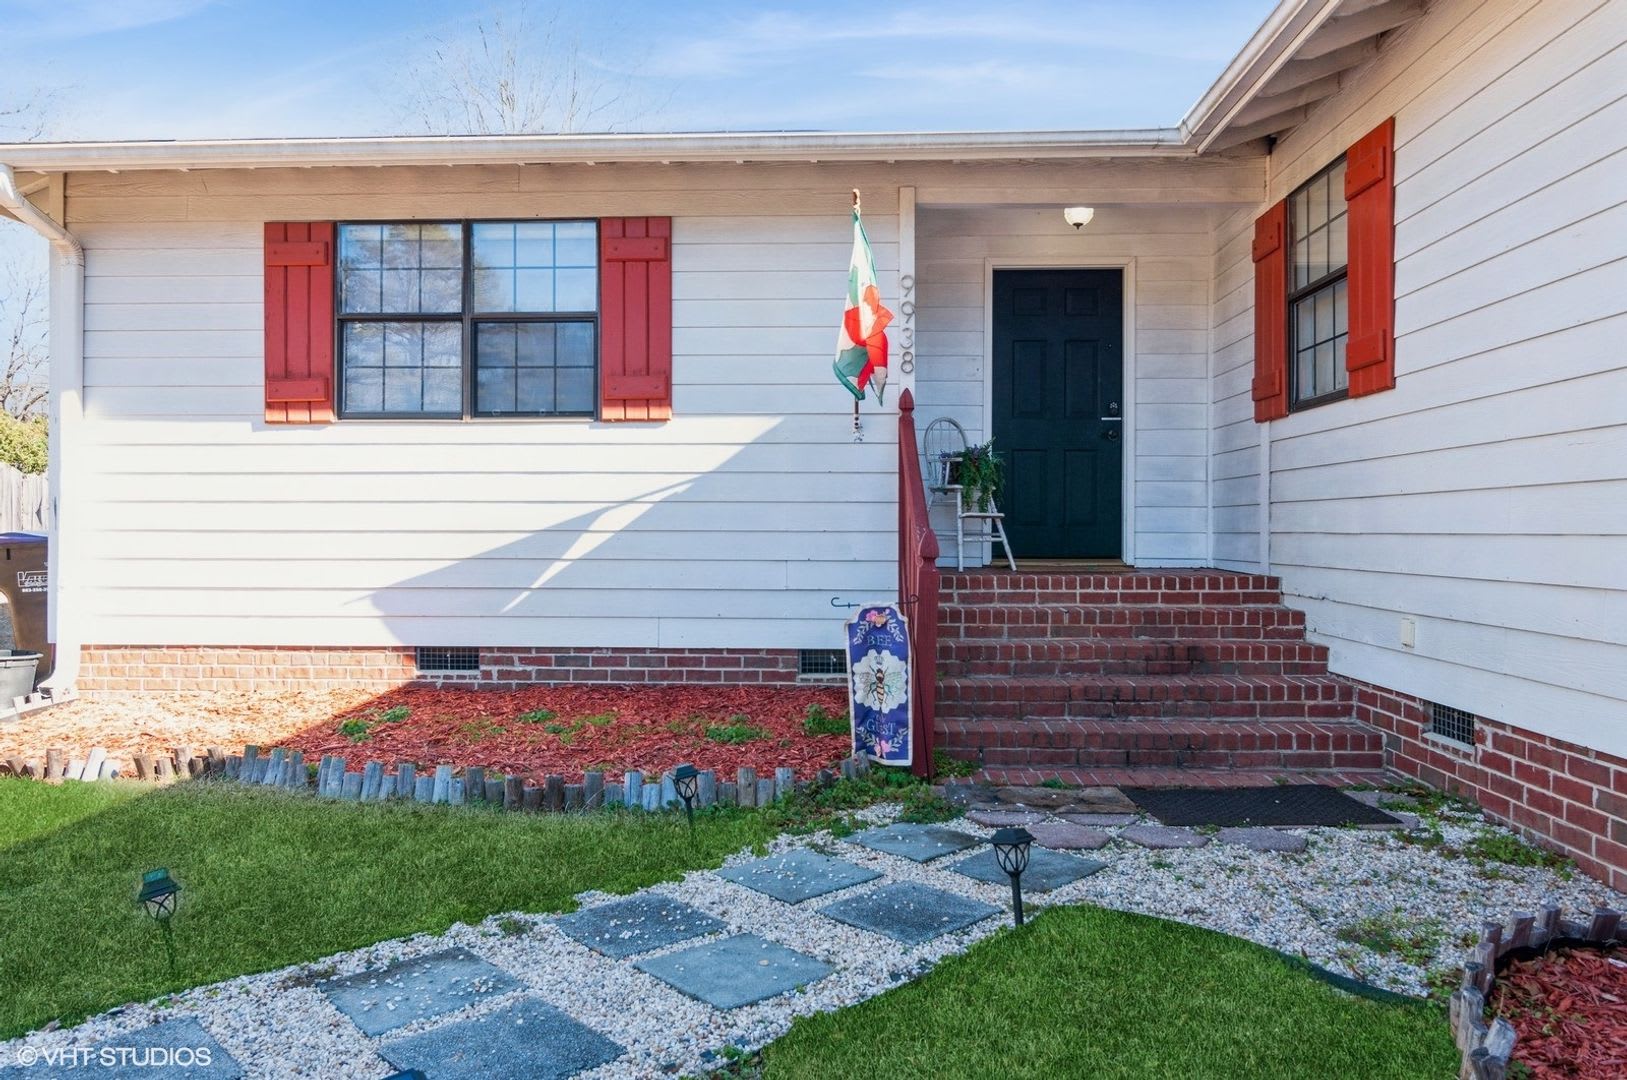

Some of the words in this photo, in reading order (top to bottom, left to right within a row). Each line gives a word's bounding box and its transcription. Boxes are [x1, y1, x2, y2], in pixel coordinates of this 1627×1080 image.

[900, 275, 915, 374] 9938
[867, 634, 893, 646] BEE
[866, 718, 896, 736] GUEST
